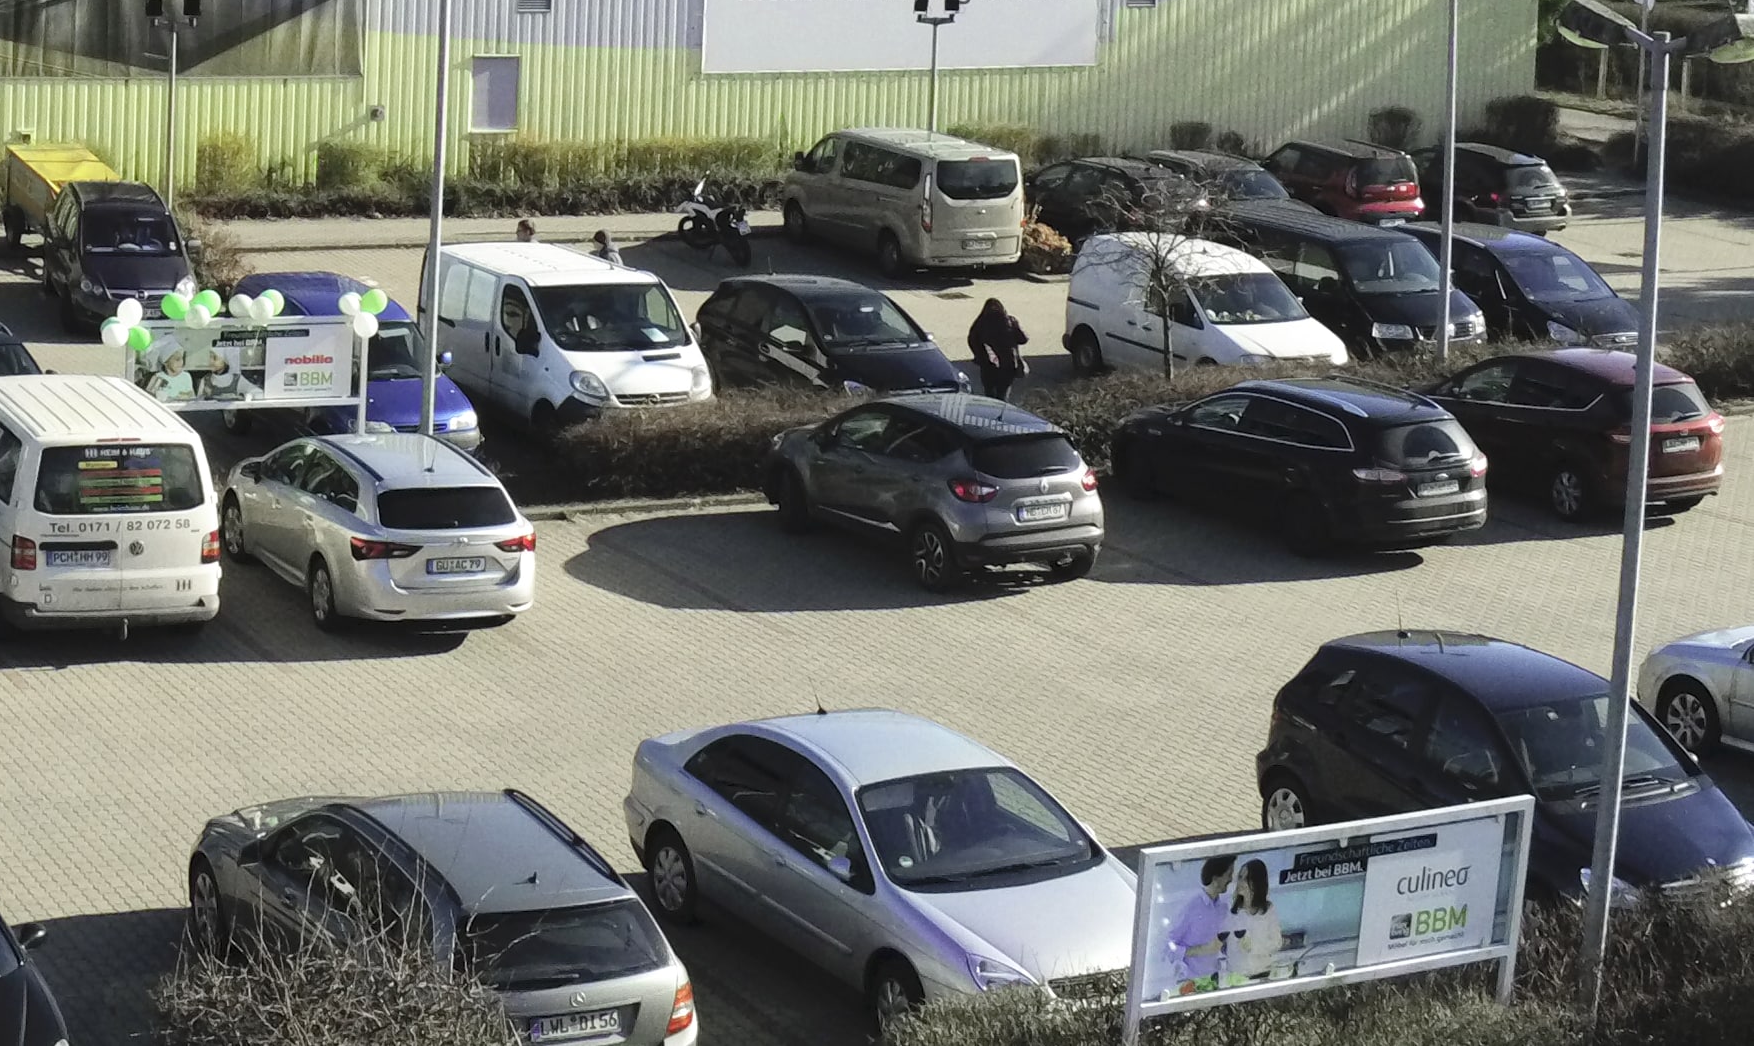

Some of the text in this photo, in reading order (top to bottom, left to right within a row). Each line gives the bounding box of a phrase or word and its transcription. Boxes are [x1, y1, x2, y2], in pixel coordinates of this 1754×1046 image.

[284, 355, 333, 365] nobilia
[300, 371, 333, 386] BBM
[49, 522, 75, 533] Tel.
[79, 522, 110, 533] 0171
[126, 520, 142, 531] 82
[147, 519, 171, 530] 072
[175, 519, 190, 529] 58
[1299, 843, 1394, 866] Freundschaftliche
[1284, 860, 1364, 884] Jetzt bei BBM.
[1415, 903, 1468, 936] BBM
[540, 1010, 617, 1035] LWL DI 56
